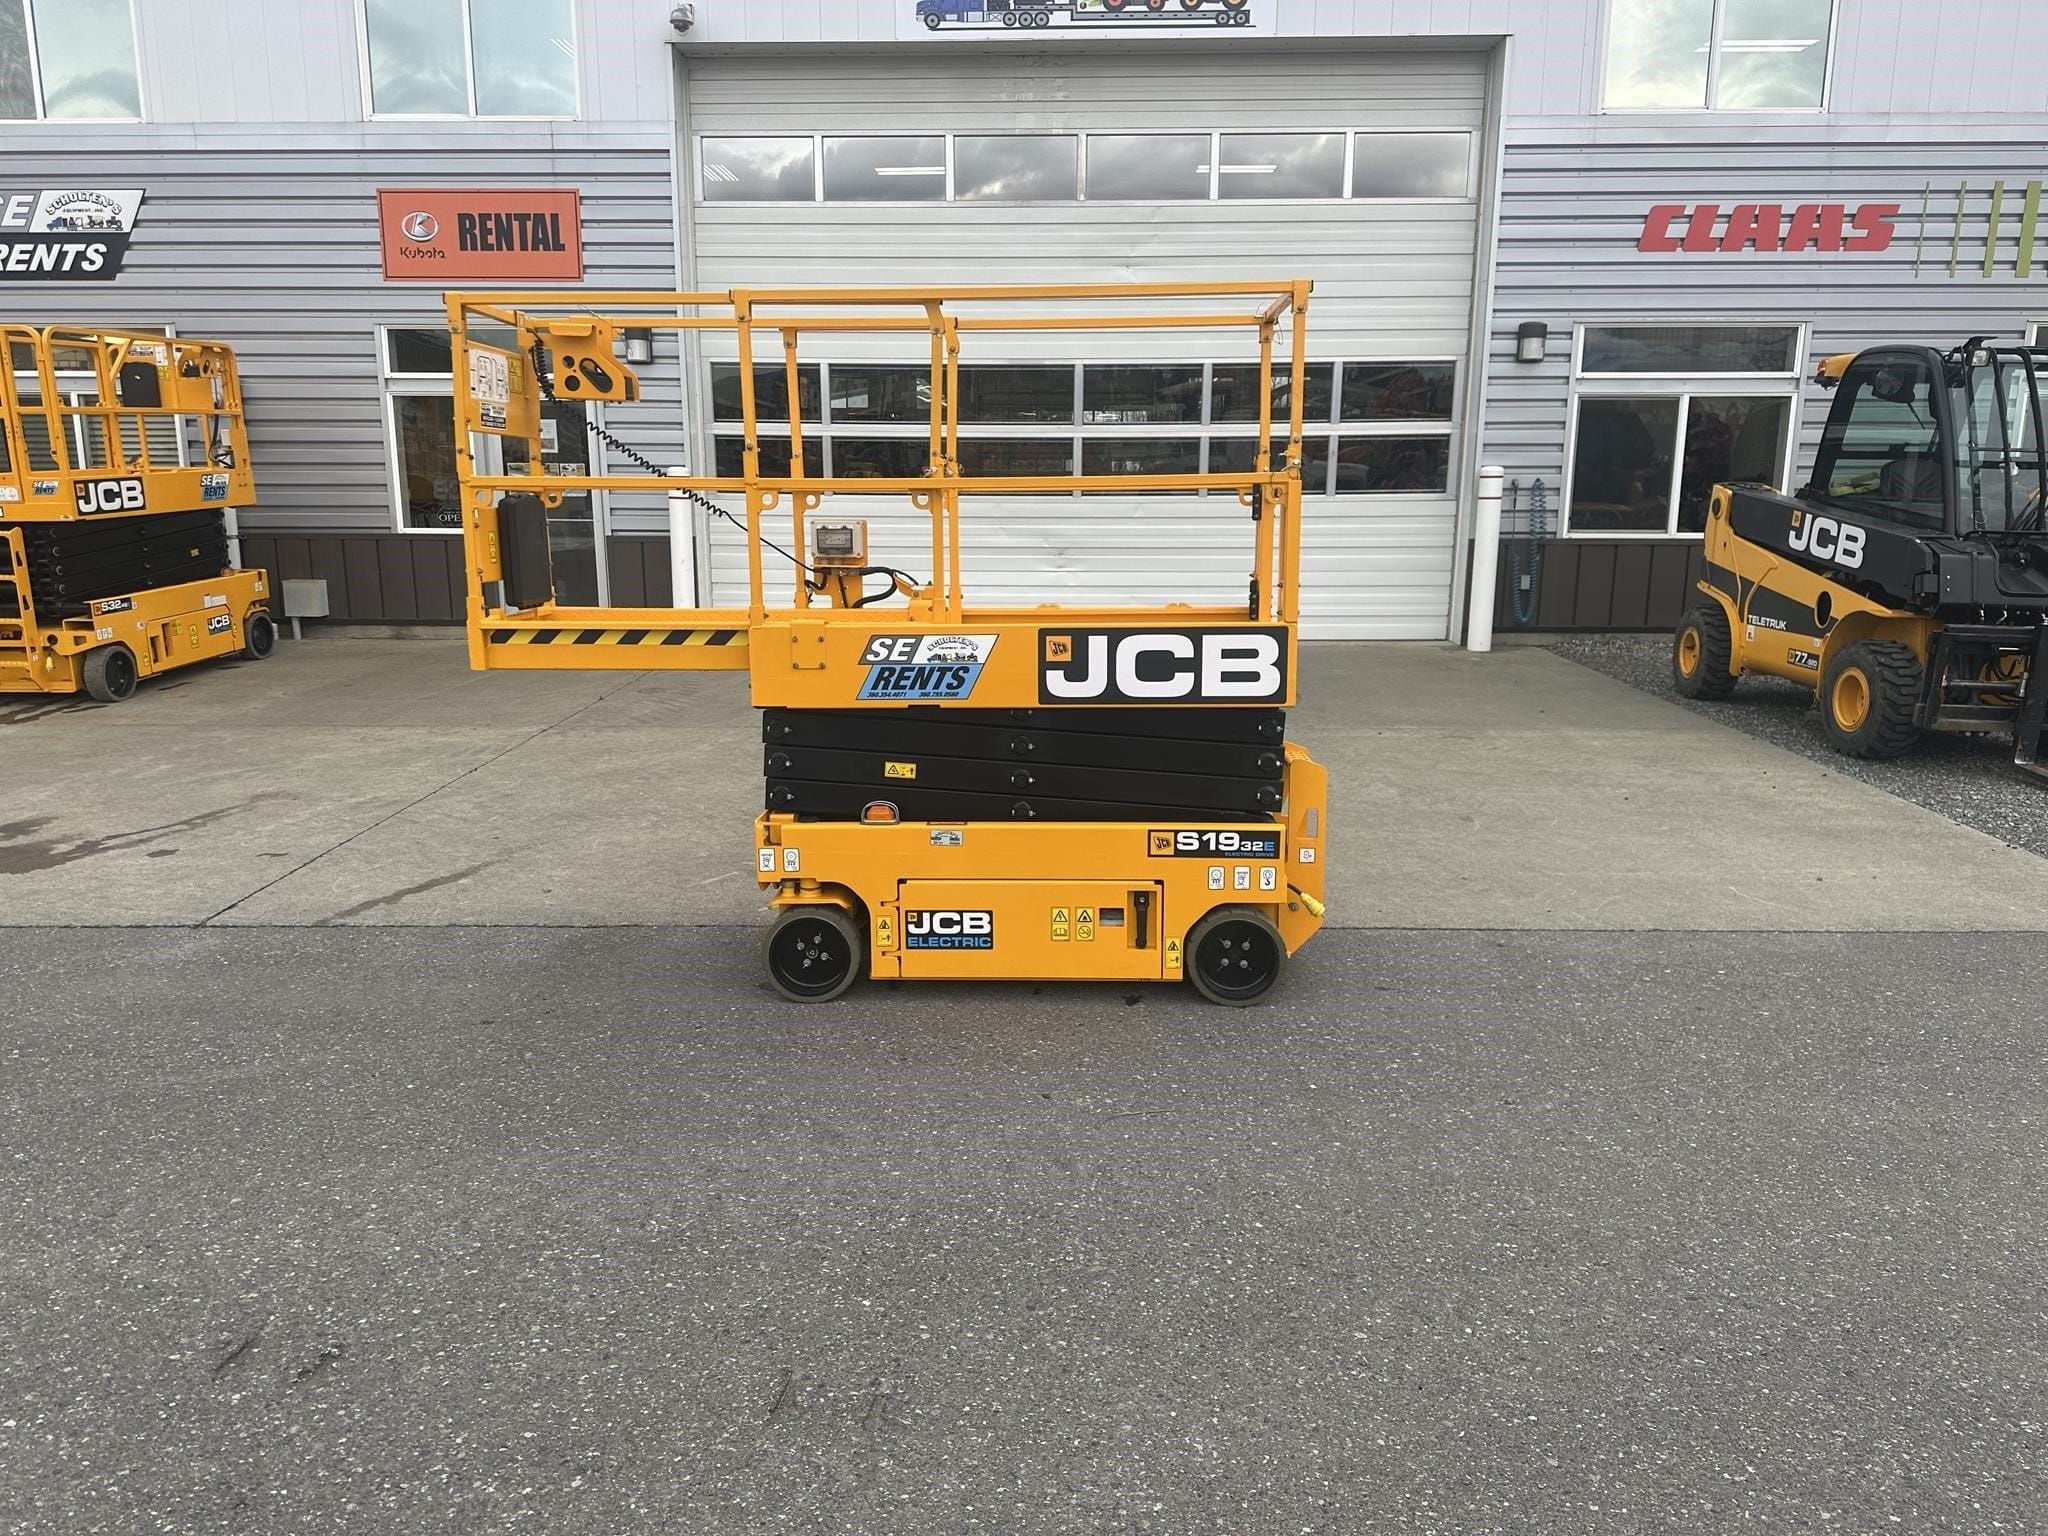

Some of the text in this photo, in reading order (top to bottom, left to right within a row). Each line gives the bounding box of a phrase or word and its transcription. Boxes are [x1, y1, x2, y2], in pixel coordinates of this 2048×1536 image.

[0, 194, 35, 227] E
[45, 190, 122, 216] SCHOLTEN'S
[457, 212, 566, 252] RENTAL
[1636, 204, 1901, 252] CLAAS
[399, 246, 446, 259] Kubota
[78, 479, 144, 513] JCB
[438, 513, 461, 522] OPE
[1788, 512, 1867, 569] JCB
[208, 614, 230, 630] JCB
[1748, 614, 1787, 630] TELETRUK
[866, 637, 917, 662] SE
[926, 636, 979, 652] SCHOLTEN'S
[870, 665, 970, 691] RENTS
[1045, 634, 1281, 698] JCB
[907, 911, 992, 935] JCB
[907, 936, 992, 947] ELECTRIC
